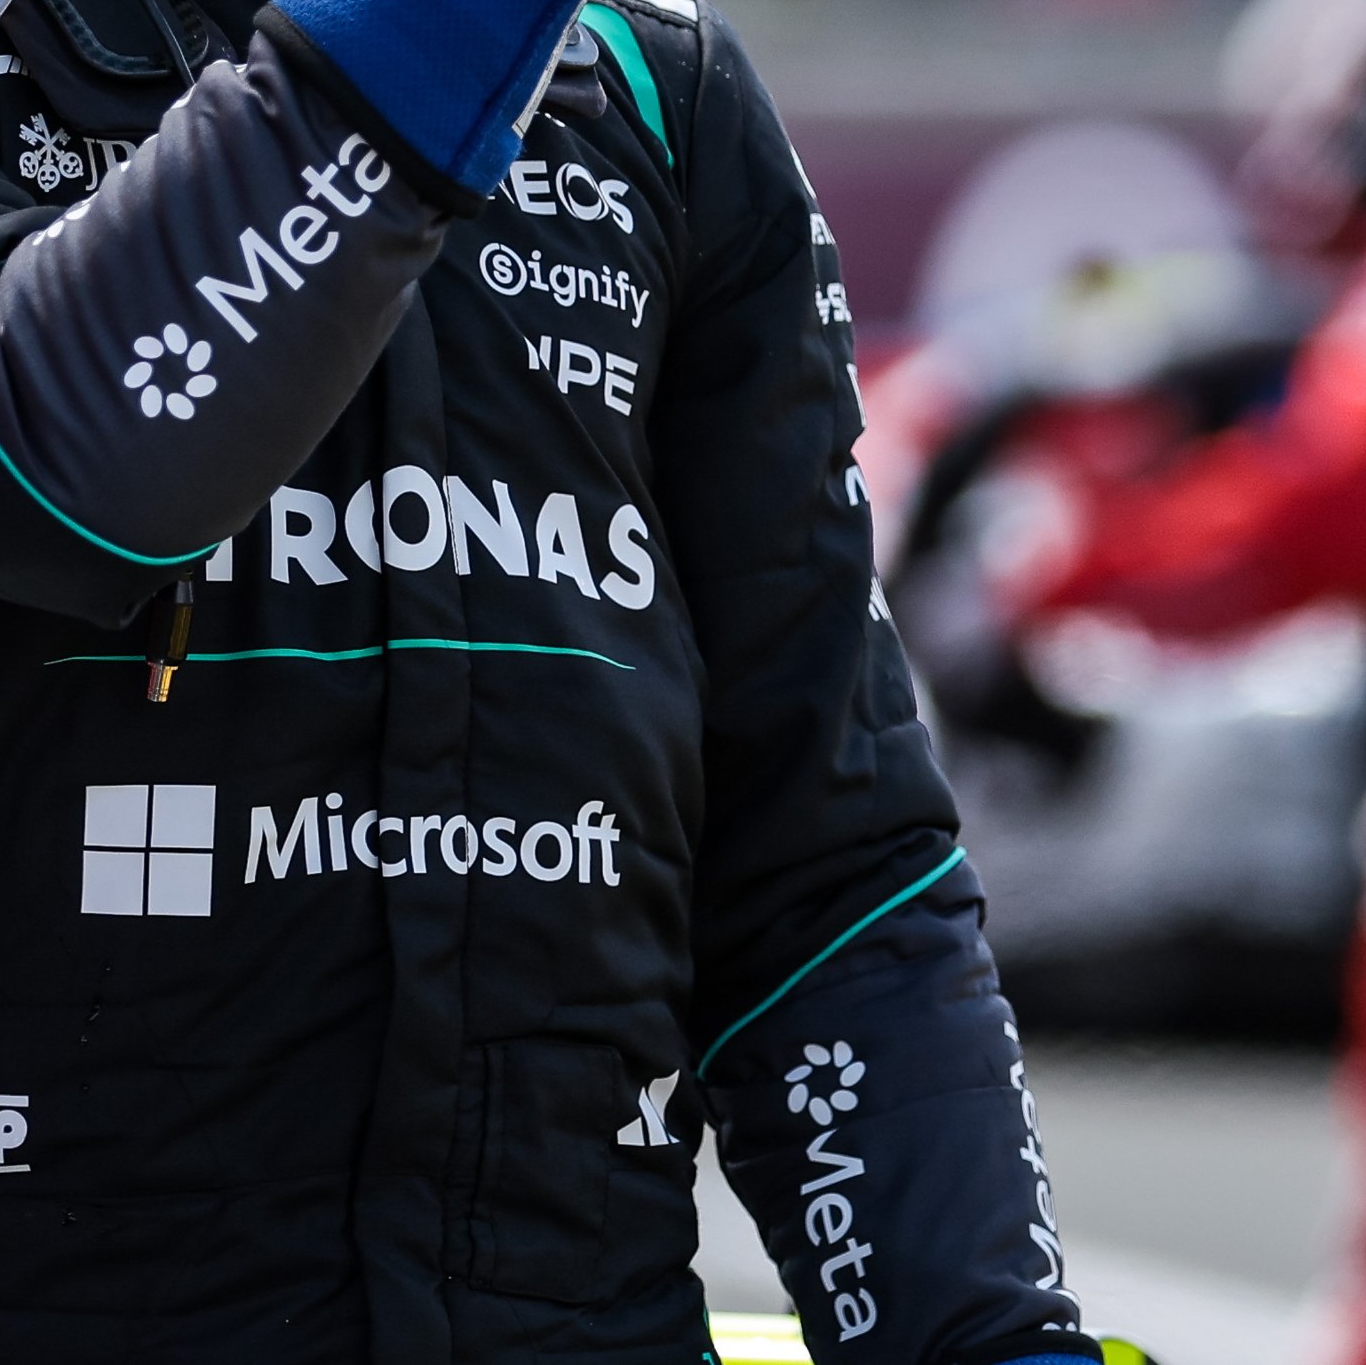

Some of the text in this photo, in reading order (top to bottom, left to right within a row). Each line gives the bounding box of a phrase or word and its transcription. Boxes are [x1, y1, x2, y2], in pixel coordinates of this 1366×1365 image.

[195, 132, 392, 344] Meta
[488, 159, 635, 235] EOS
[205, 464, 656, 611] RONAS
[244, 791, 622, 888] Microsoft
[800, 1129, 879, 1343] Meta
